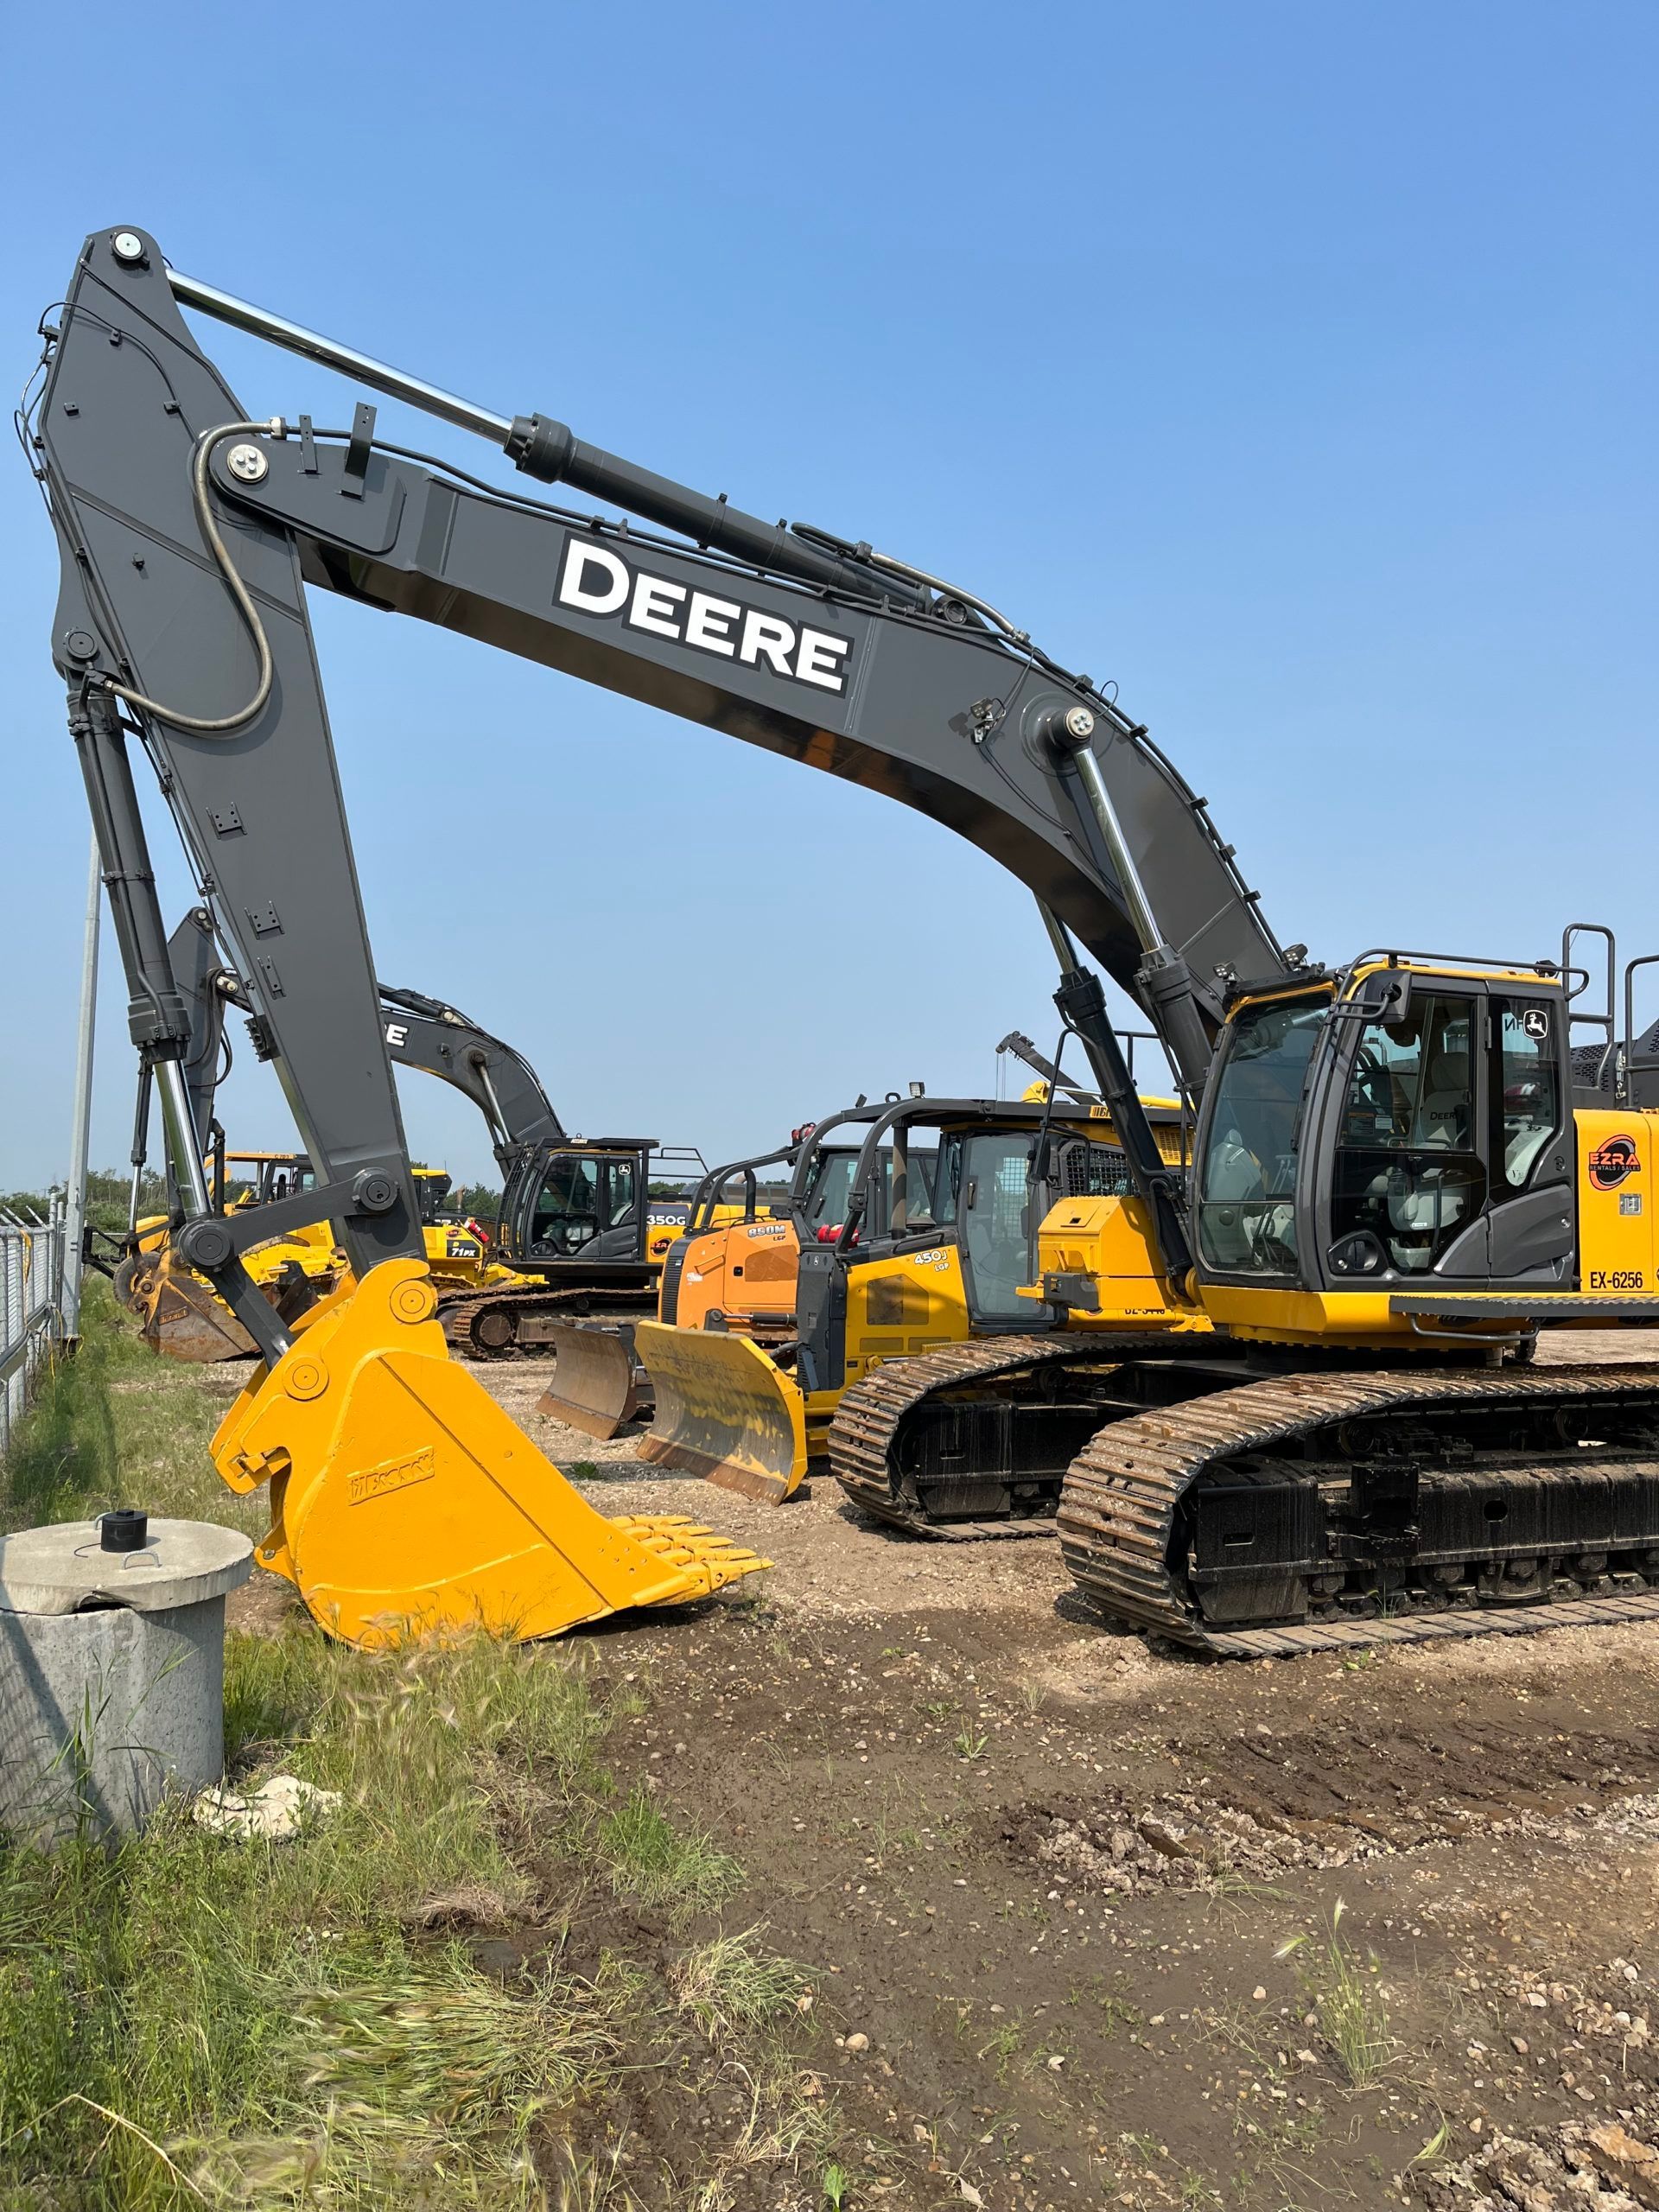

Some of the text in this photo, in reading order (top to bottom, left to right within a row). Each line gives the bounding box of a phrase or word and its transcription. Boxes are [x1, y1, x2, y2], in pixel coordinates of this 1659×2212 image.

[558, 537, 850, 692] DEERE
[385, 1023, 409, 1046] E
[1430, 1111, 1458, 1121] DEER
[1589, 1152, 1640, 1166] EZRA
[645, 1214, 687, 1226] 350G
[747, 1224, 786, 1238] 850M
[914, 1249, 948, 1266] 450J
[934, 1262, 950, 1272] LGP
[1590, 1271, 1643, 1289] EX-6256
